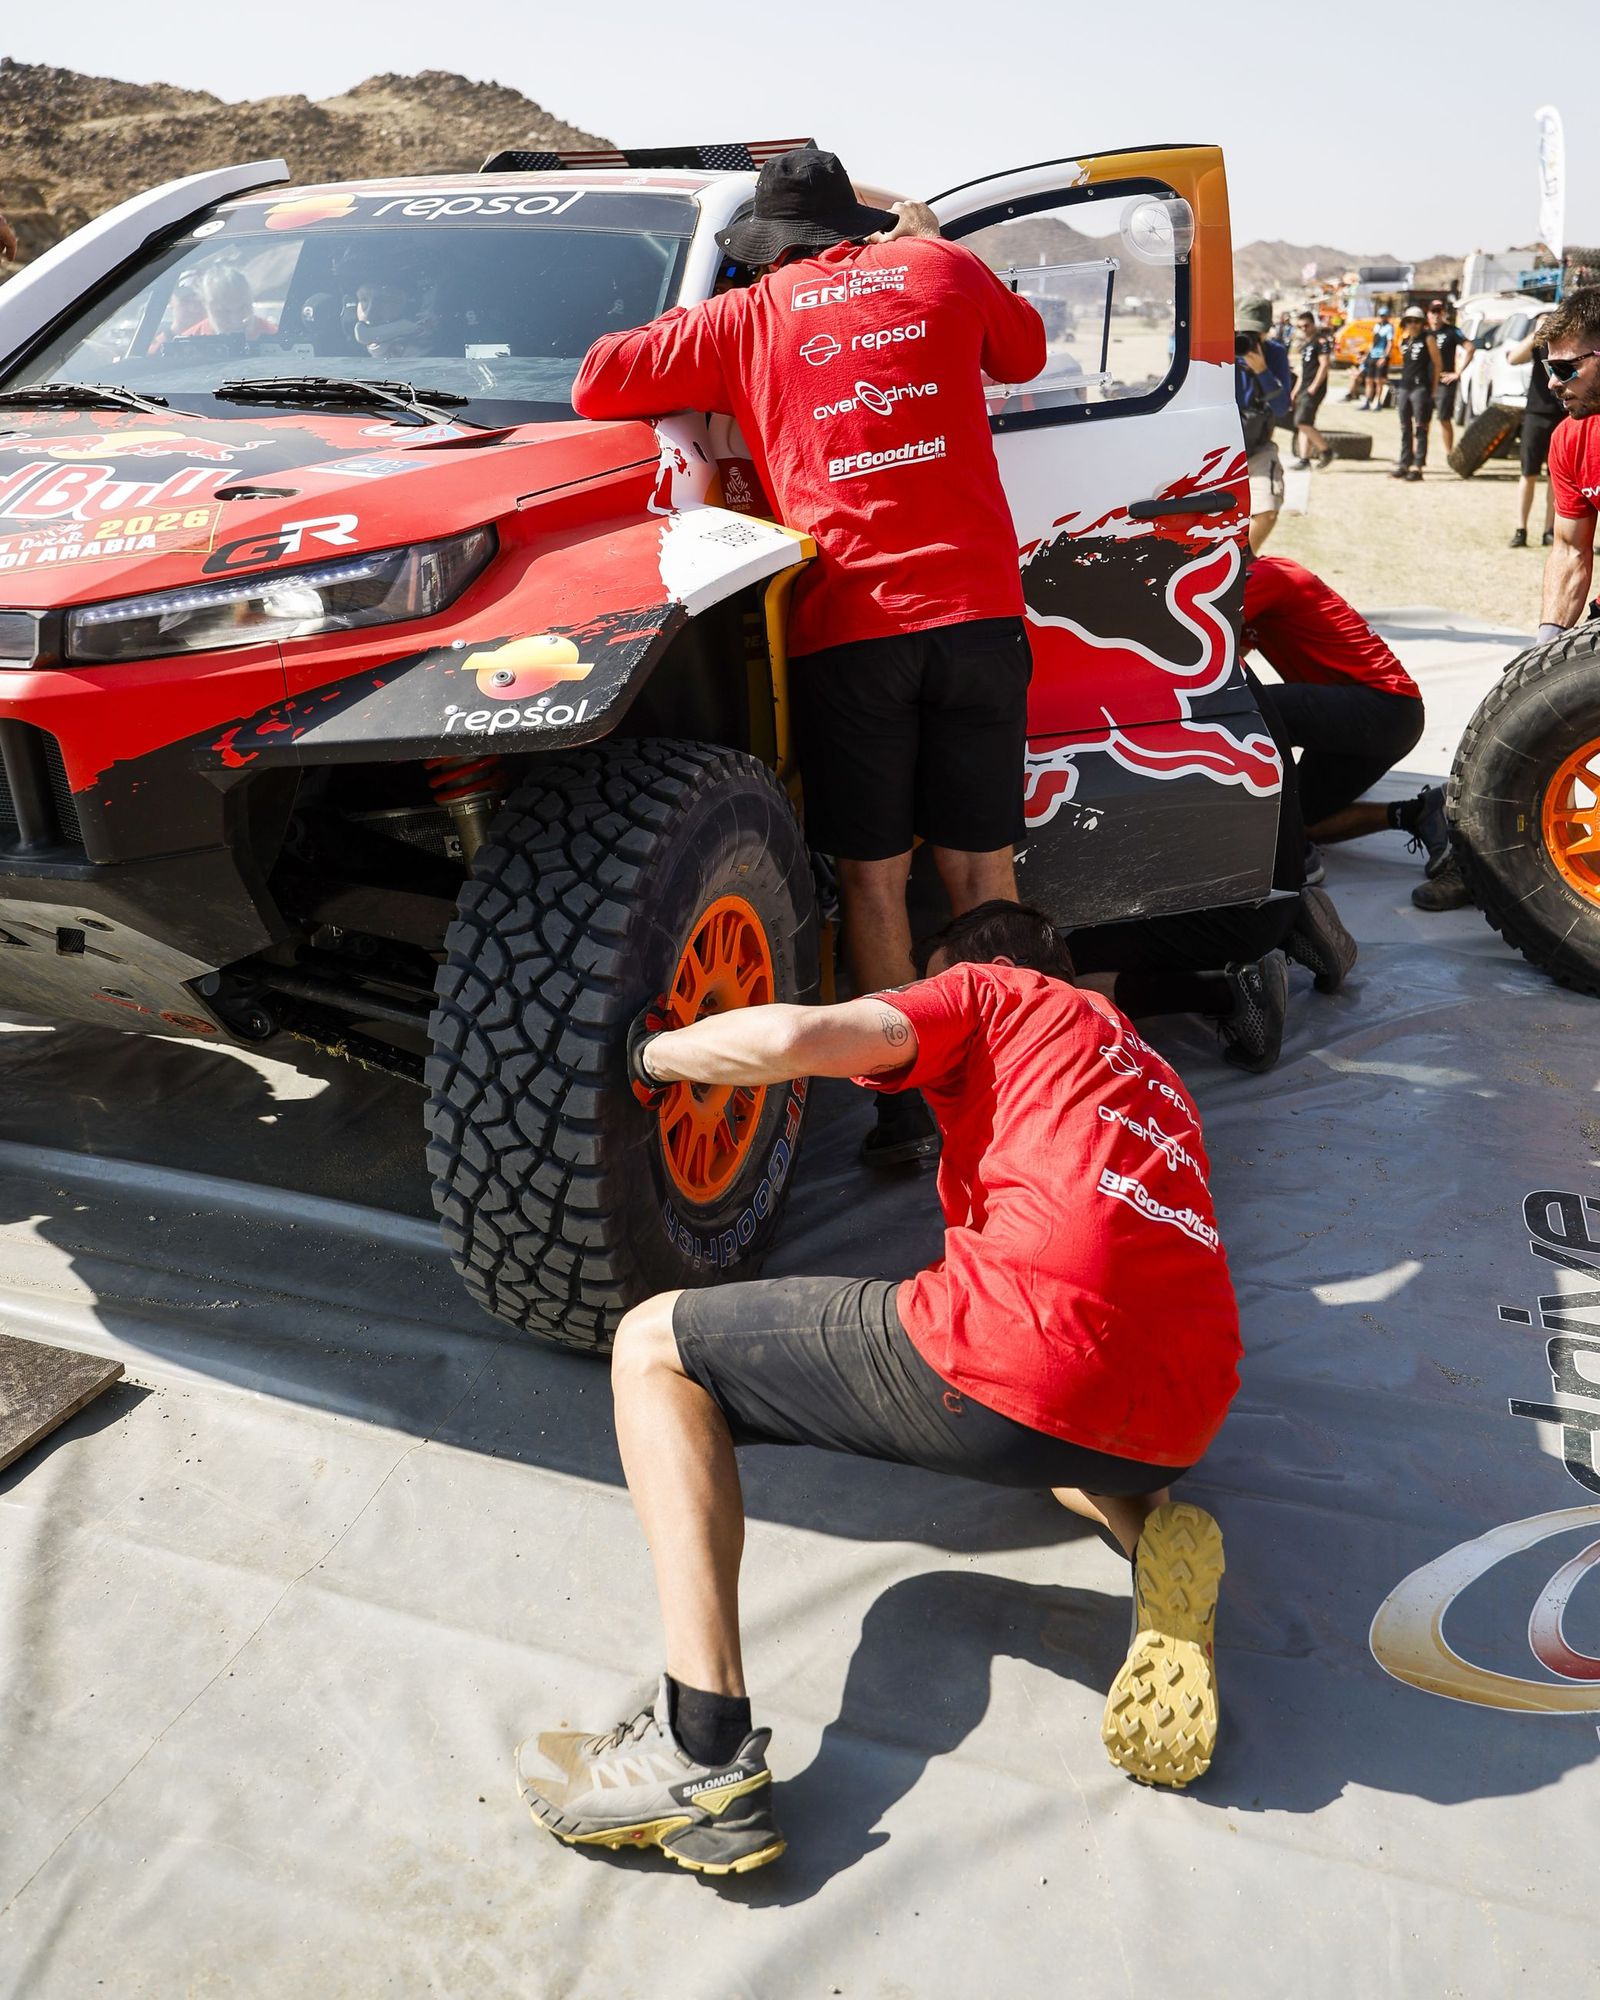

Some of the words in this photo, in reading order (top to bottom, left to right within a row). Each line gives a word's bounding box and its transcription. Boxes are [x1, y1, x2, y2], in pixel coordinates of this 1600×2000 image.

[372, 191, 586, 220] repsol
[794, 285, 845, 308] GR
[849, 283, 905, 298] Racing
[851, 320, 926, 350] repsol
[829, 436, 945, 477] BFGoodrich
[1, 463, 243, 520] Bull
[95, 509, 209, 540] 2026
[35, 534, 156, 564] ARABIA
[201, 513, 359, 574] GR
[444, 700, 589, 736] repsol
[1099, 1168, 1219, 1247] BFGoodrich
[682, 1770, 744, 1798] SALOMON
